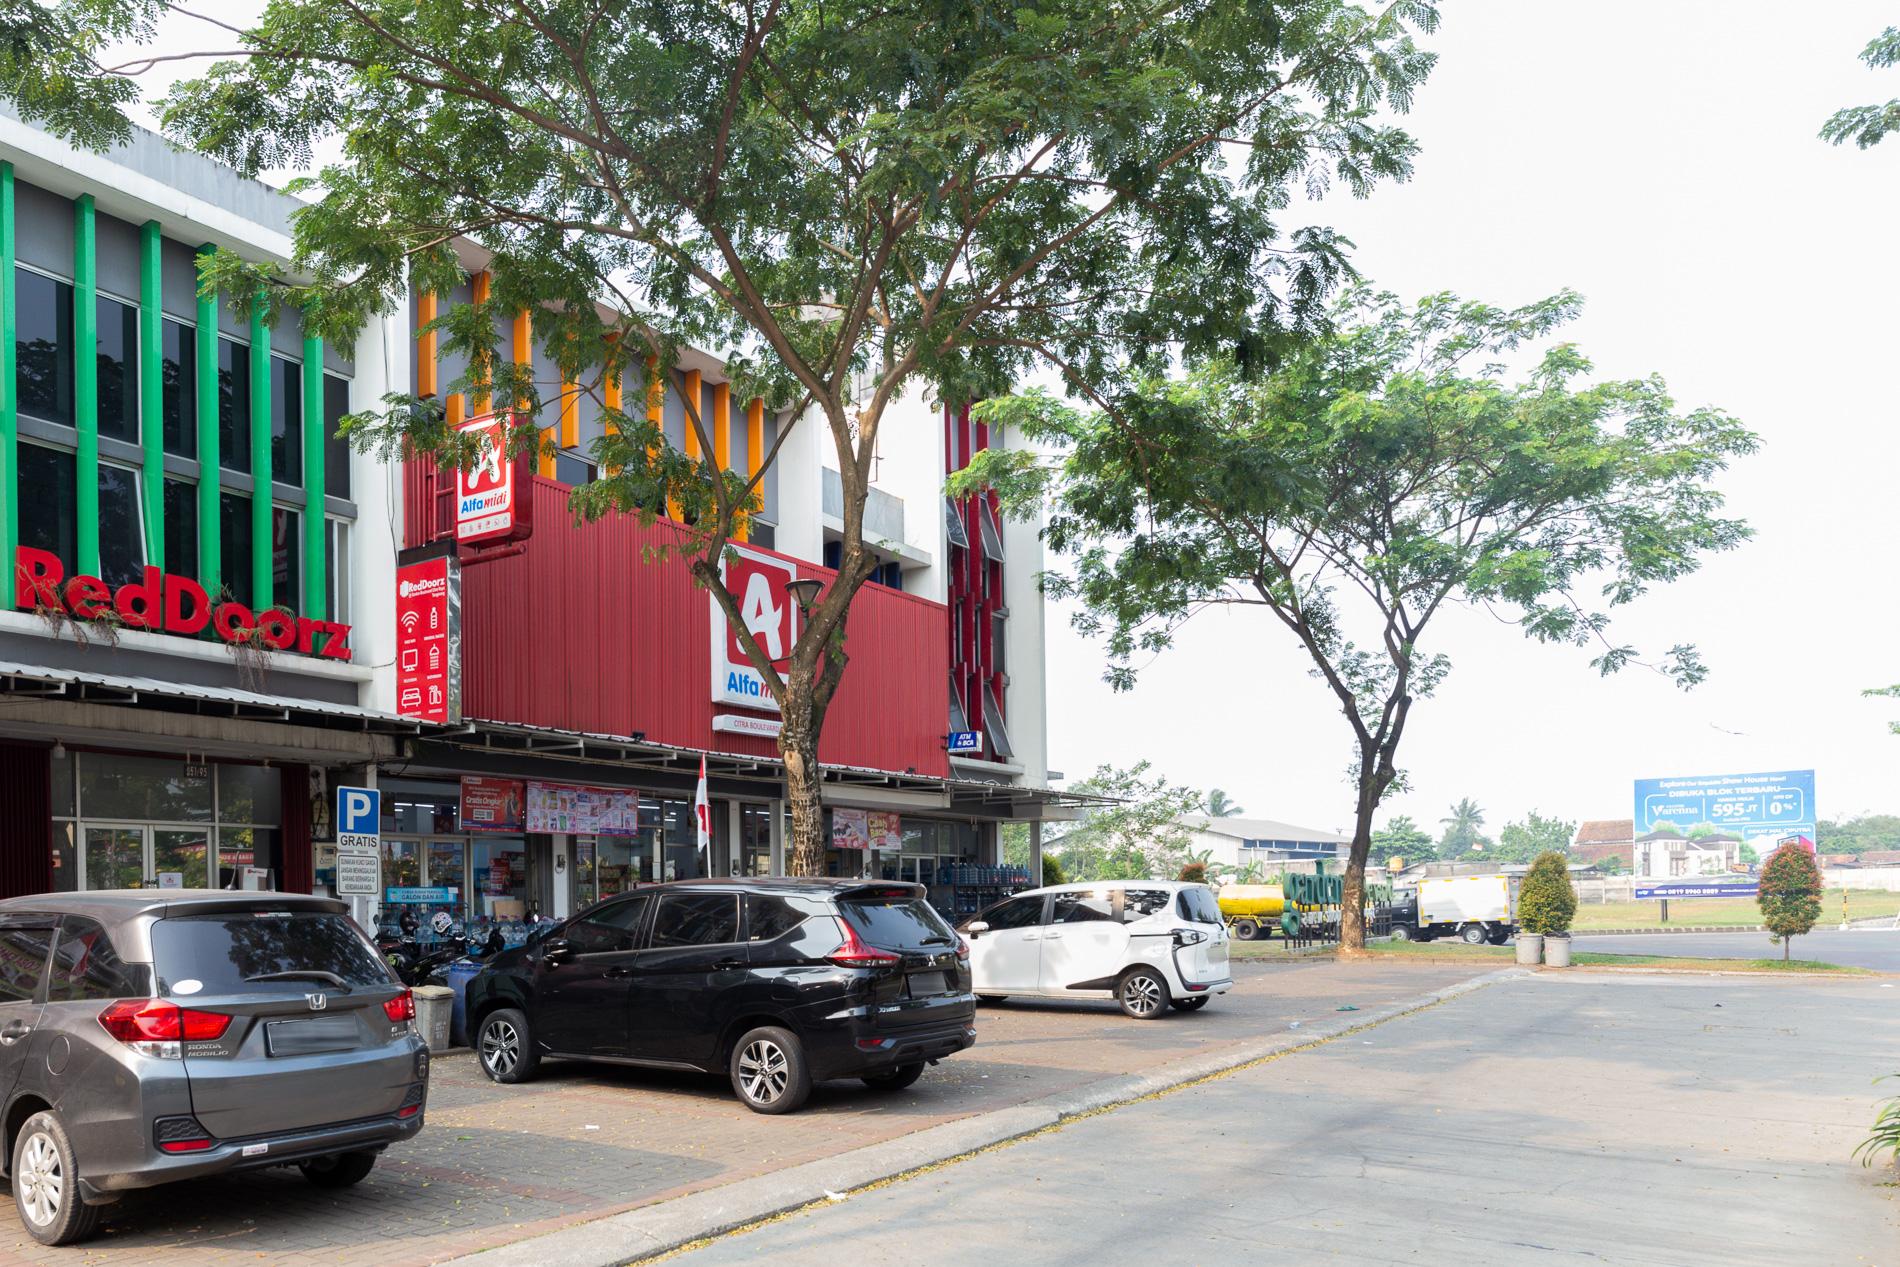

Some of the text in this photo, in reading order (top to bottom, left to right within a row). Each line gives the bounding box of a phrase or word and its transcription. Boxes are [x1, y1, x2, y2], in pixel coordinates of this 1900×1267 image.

[461, 491, 507, 514] Alfamidi
[408, 577, 446, 592] RedDoorz
[15, 545, 353, 661] RedDoorz
[727, 671, 774, 699] Alfam
[734, 720, 749, 729] CITRA
[1668, 786, 1780, 798] DIBUKA BLOK TERBARU
[346, 792, 371, 831] P
[1651, 804, 1698, 817] Varenna
[1712, 802, 1758, 817] 595 JT
[340, 835, 377, 848] GRATIS
